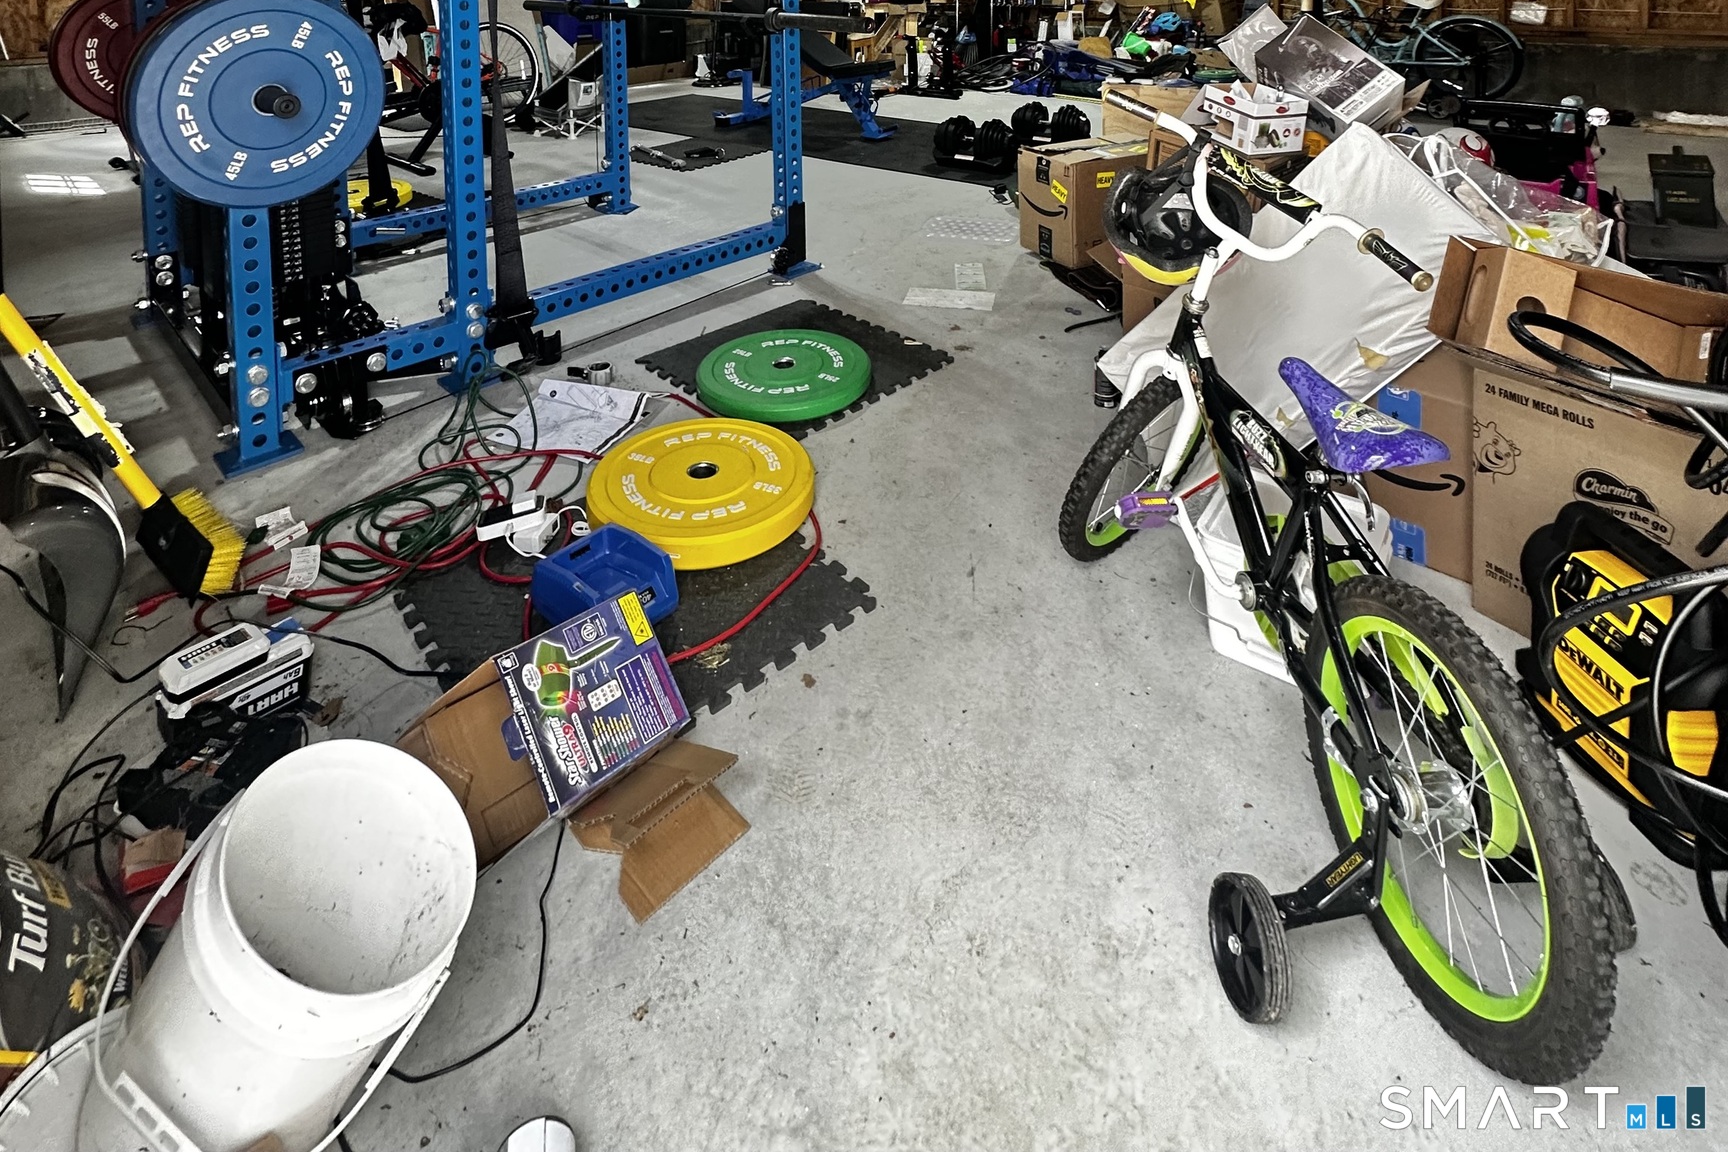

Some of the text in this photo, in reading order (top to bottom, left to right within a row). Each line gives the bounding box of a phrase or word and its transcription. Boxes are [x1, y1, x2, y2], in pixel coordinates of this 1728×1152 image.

[98, 12, 119, 30] 55LB
[292, 21, 312, 50] 45LB
[85, 38, 114, 94] ITNESS
[176, 24, 270, 153] REP FITNESS
[270, 50, 354, 174] REP FITNESS
[225, 151, 248, 182] 45LB
[732, 348, 753, 358] 25LB
[760, 338, 844, 369] REP FITNESS
[724, 361, 811, 395] REP FITNESS
[818, 372, 840, 382] 25LB
[1484, 382, 1595, 430] 24 FAMILY MEGA ROLLS
[1246, 418, 1268, 444] BUZZ
[627, 452, 656, 465] 35LB
[664, 432, 782, 472] REP FITNESS
[621, 473, 748, 521] REP FITNESS
[753, 480, 783, 496] 35LB
[1581, 476, 1638, 503] Charmin
[1628, 510, 1650, 524] the
[1651, 520, 1668, 534] go
[283, 667, 300, 681] 6Ah
[1560, 638, 1625, 702] DEWALT
[247, 681, 297, 715] HART
[547, 715, 584, 786] Star Shower
[1327, 853, 1361, 885] LIGHTYEAR
[8, 888, 46, 972] Turf
